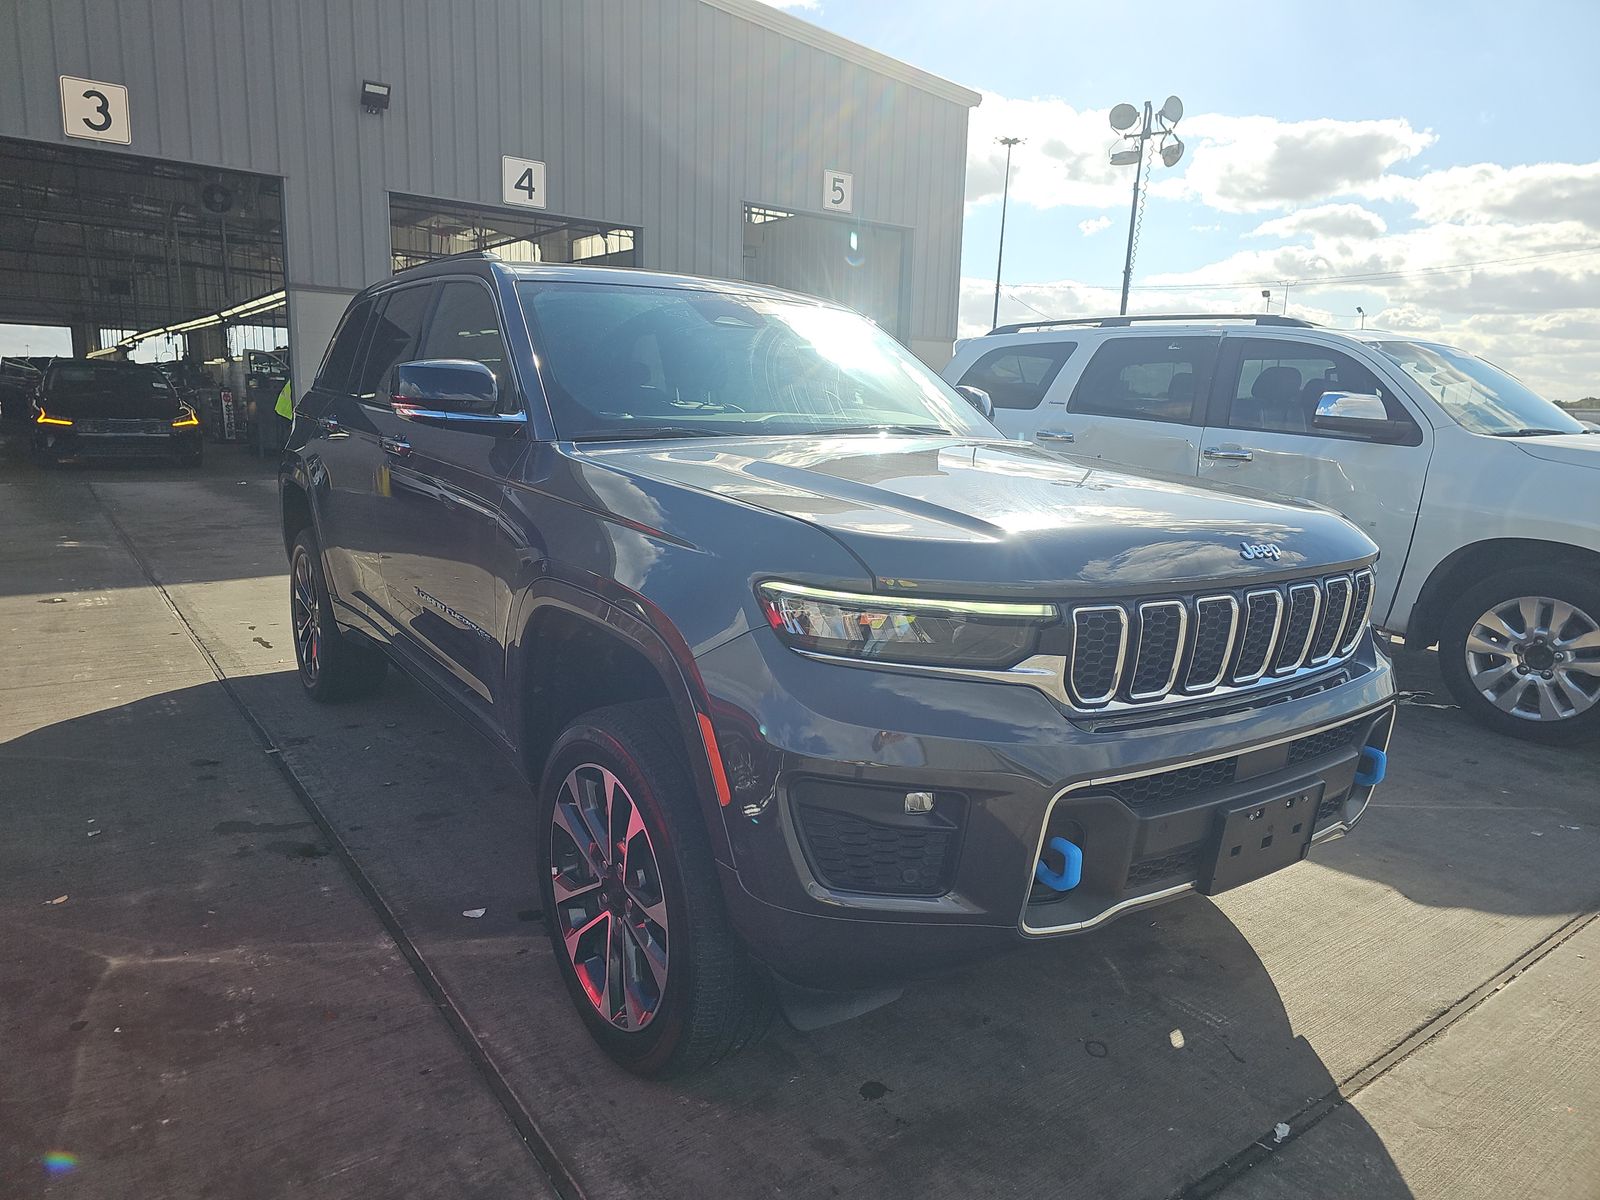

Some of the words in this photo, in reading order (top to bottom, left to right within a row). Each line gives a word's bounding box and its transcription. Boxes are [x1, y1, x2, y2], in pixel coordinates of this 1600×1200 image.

[82, 90, 112, 131] 3
[514, 168, 535, 199] 4
[831, 177, 844, 204] 5
[1240, 541, 1281, 561] Jeep
